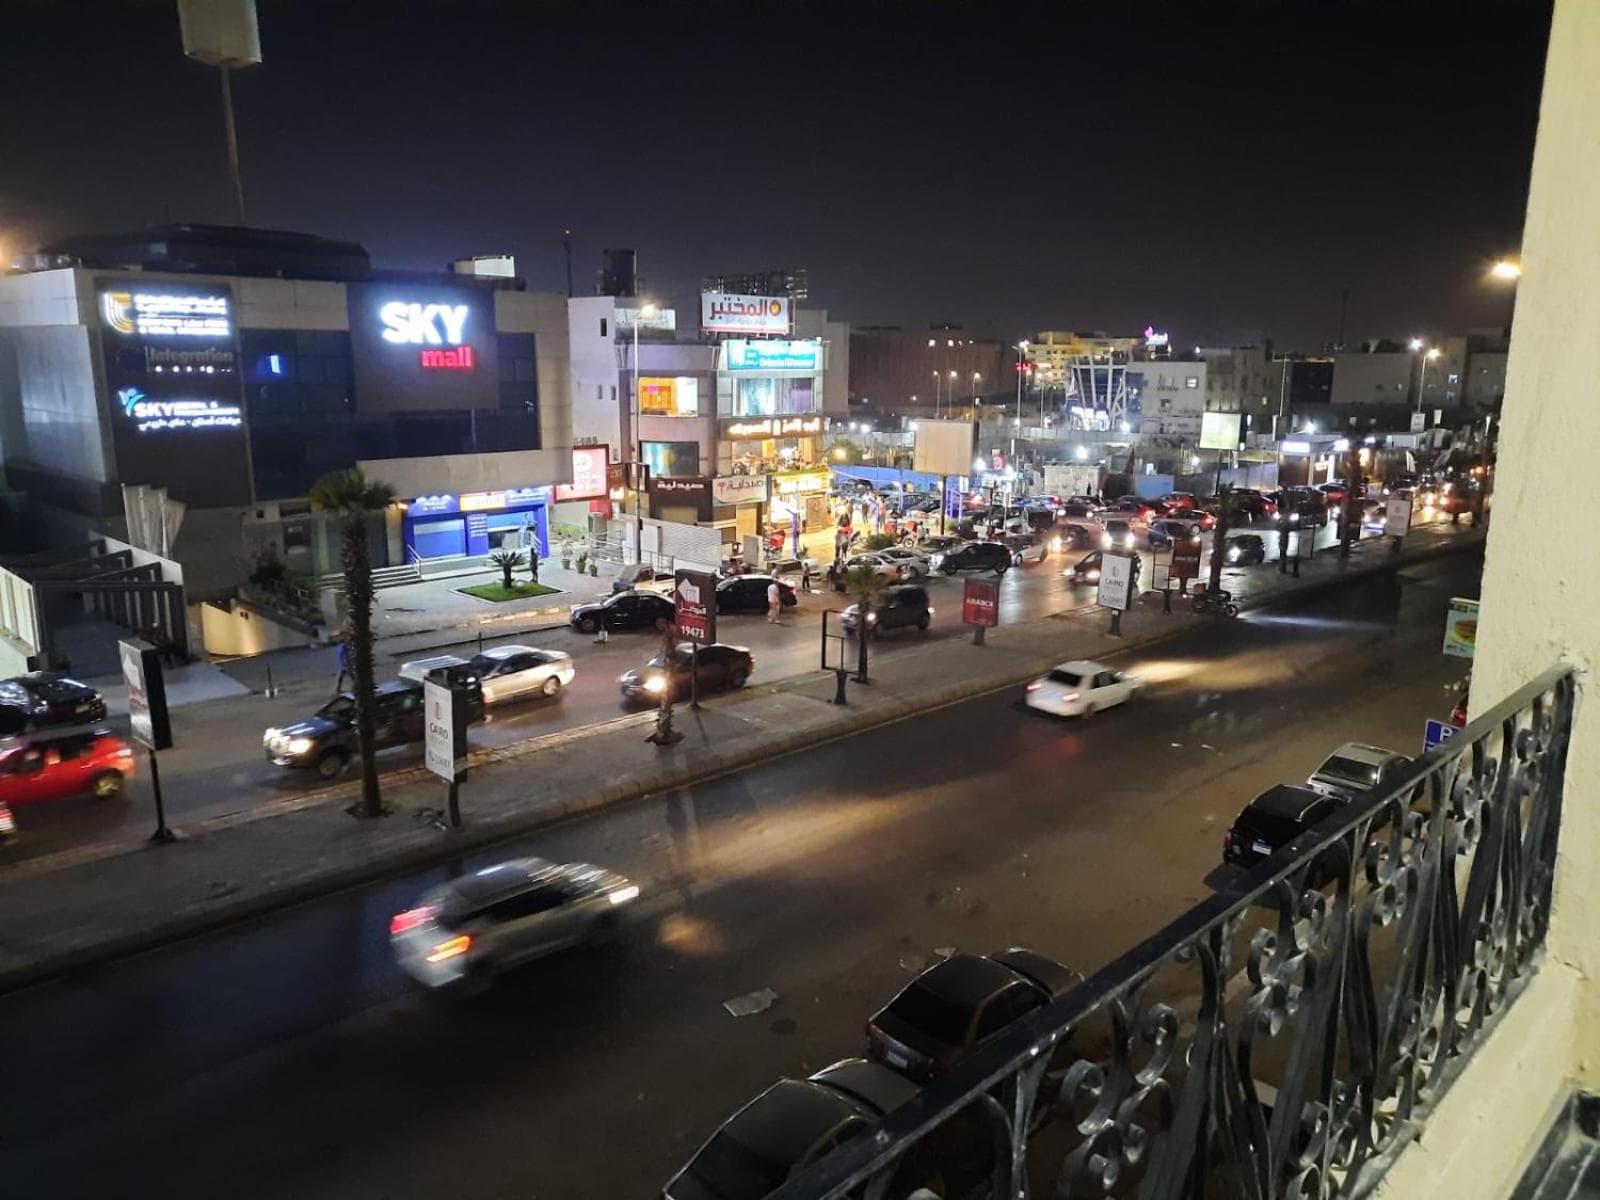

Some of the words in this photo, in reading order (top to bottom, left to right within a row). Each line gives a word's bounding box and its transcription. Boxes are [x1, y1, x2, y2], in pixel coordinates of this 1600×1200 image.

[709, 297, 767, 320] المختبر
[380, 302, 468, 344] SKY
[421, 346, 472, 367] mall
[133, 402, 173, 417] SKY
[681, 625, 704, 639] 19473
[1440, 725, 1453, 742] P
